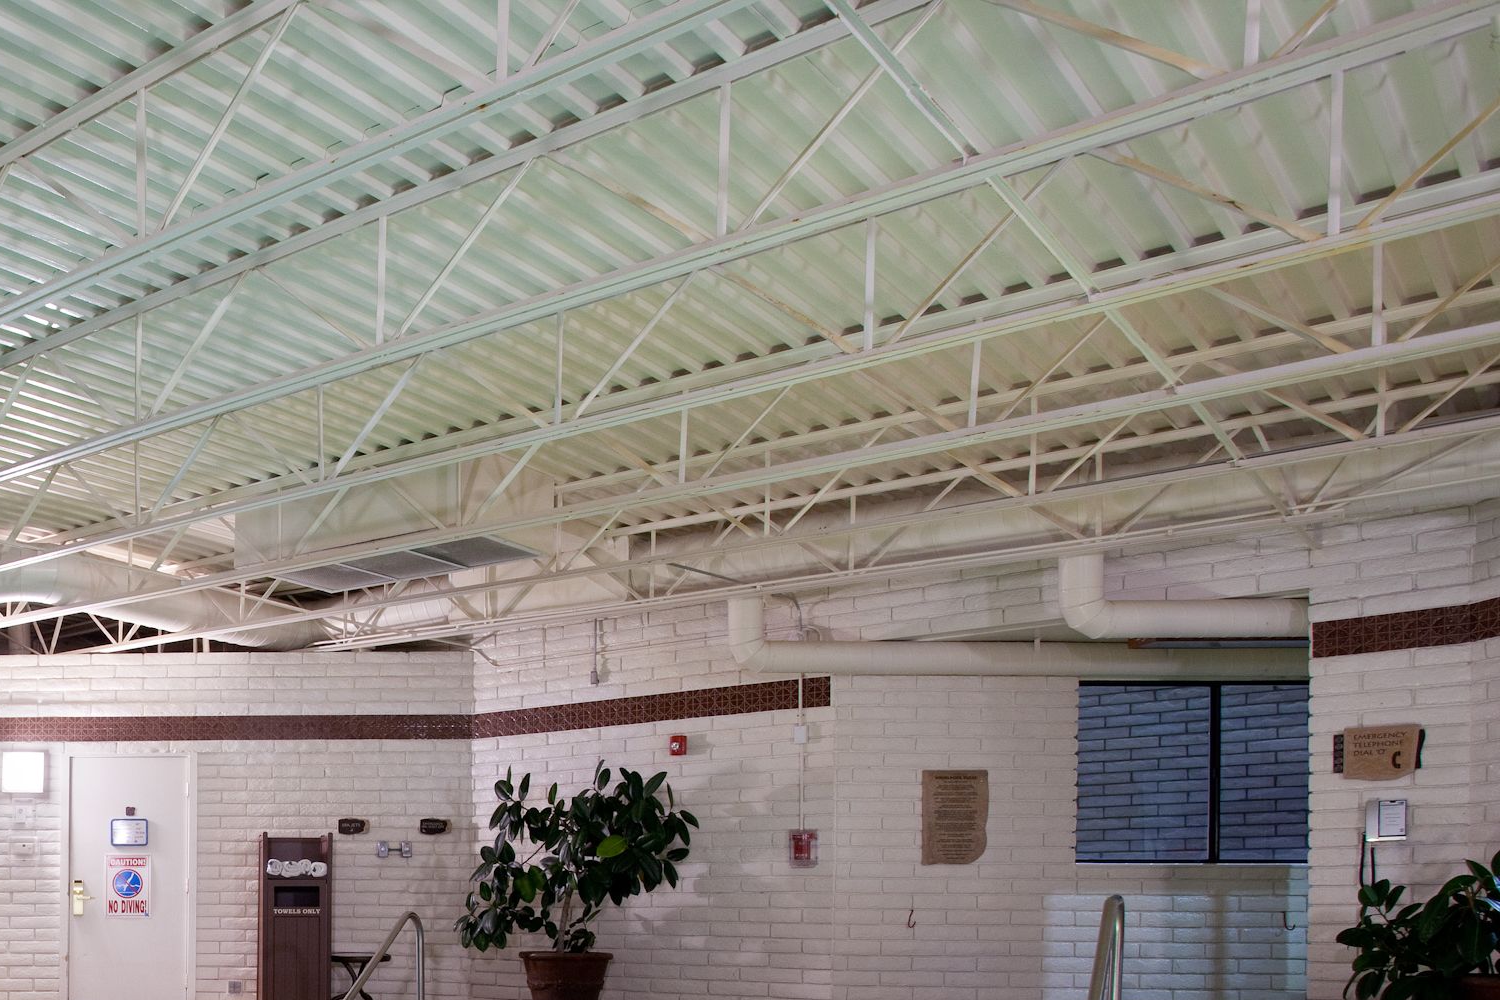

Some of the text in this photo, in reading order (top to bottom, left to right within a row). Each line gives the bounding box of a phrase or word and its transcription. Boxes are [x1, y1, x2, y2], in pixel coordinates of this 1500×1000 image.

[1353, 732, 1406, 740] EMERGENCY
[1353, 740, 1404, 748] TELEPHONE
[1353, 749, 1373, 757] DIAL
[110, 858, 147, 866] CAUTION!
[108, 900, 147, 914] NO DIVING!
